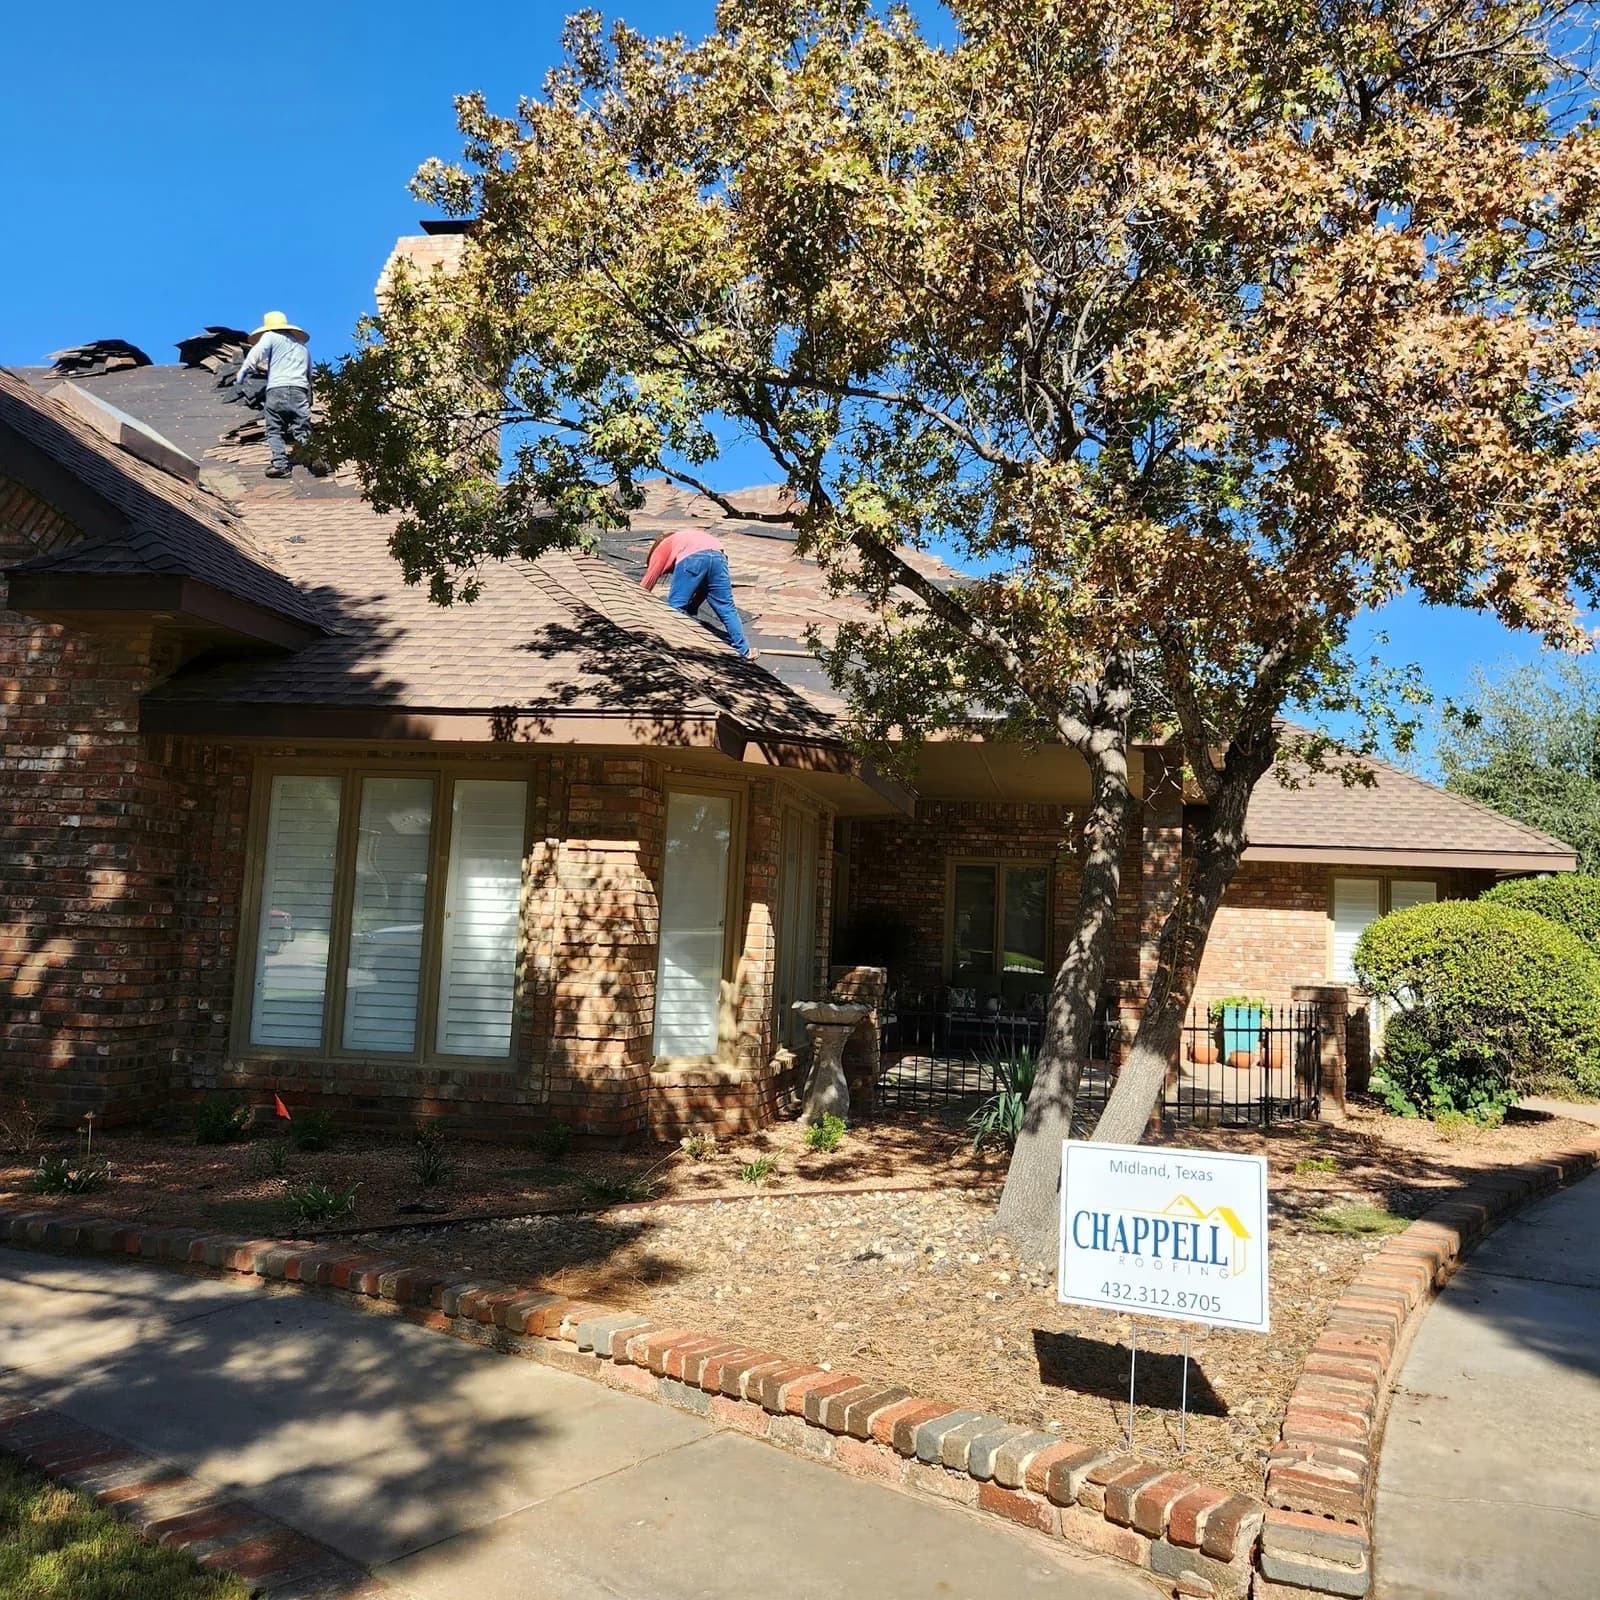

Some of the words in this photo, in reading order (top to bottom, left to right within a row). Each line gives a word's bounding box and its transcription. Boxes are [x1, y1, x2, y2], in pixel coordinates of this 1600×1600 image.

[1109, 1159, 1170, 1179] Midland,
[1175, 1165, 1213, 1182] Texas
[1072, 1210, 1228, 1266] CHAPPELL
[1118, 1256, 1229, 1279] ROOFING
[1100, 1281, 1221, 1313] 432.312.8705
